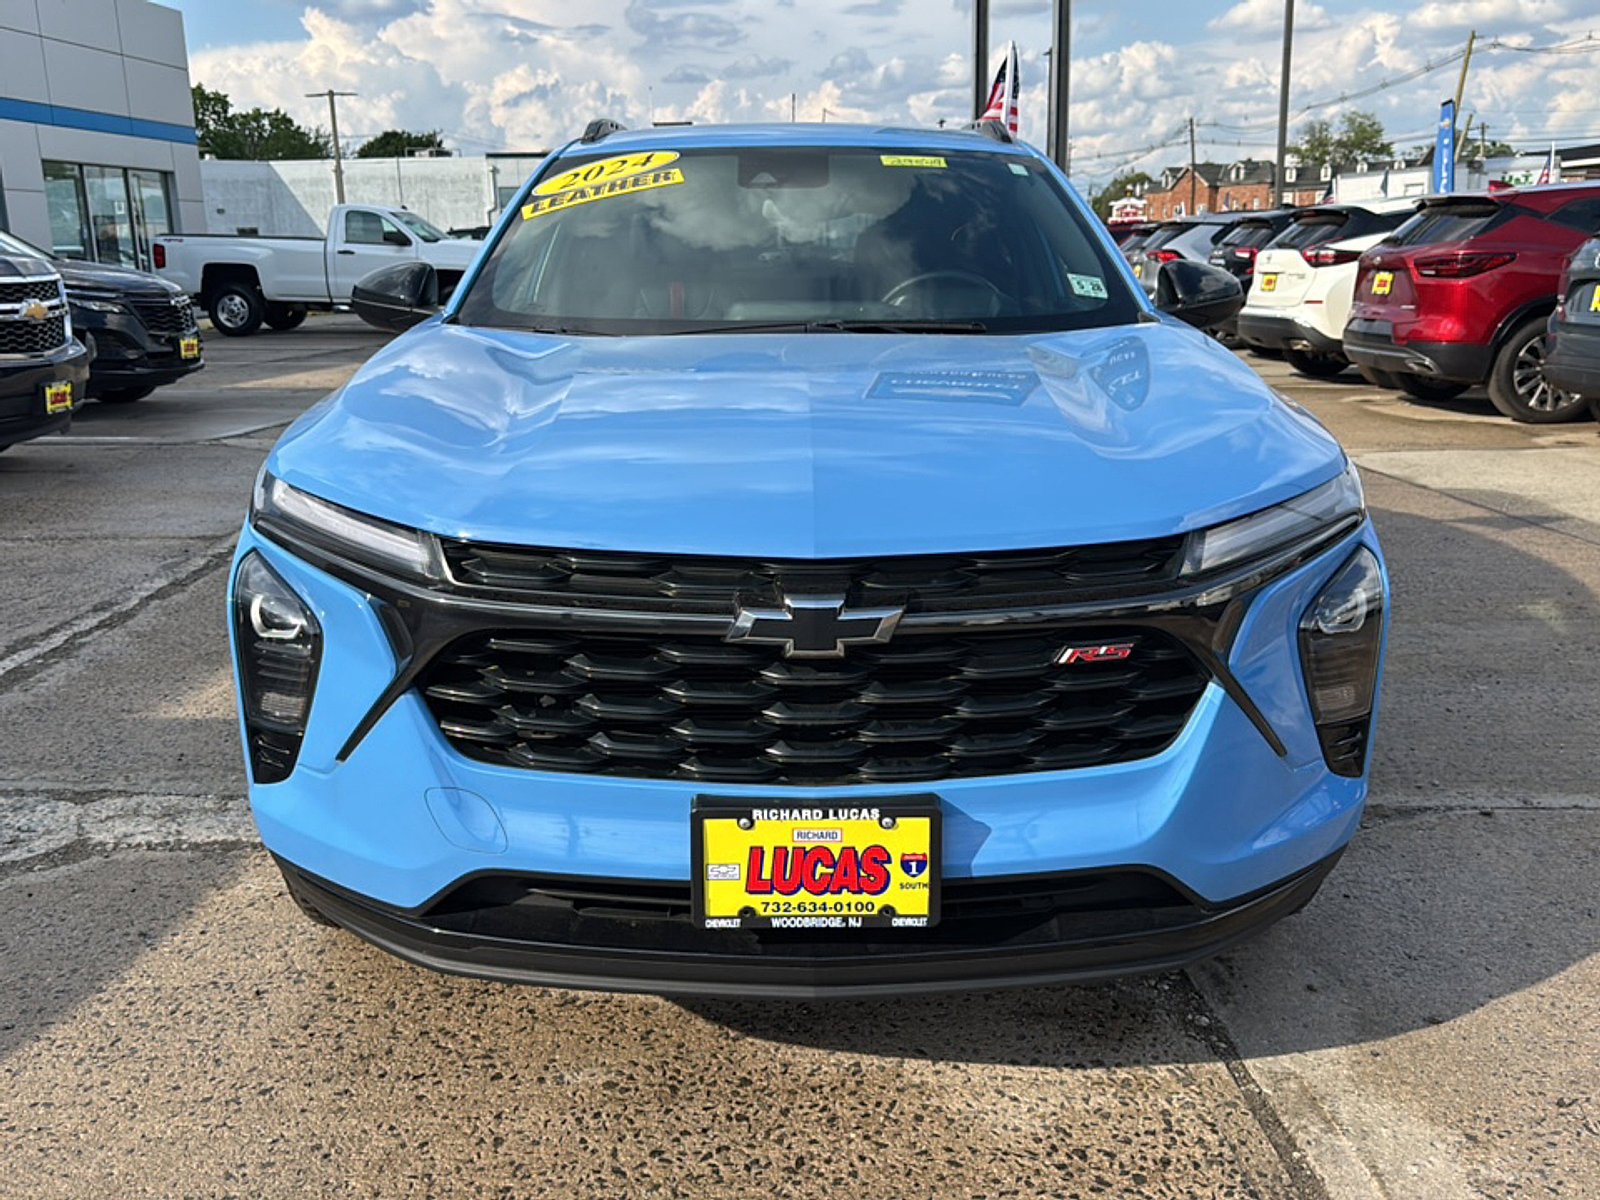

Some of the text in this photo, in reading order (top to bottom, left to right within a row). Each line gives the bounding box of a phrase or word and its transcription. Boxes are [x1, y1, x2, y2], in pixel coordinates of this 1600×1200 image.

[559, 153, 655, 190] 2024
[530, 171, 676, 213] LEATHER
[1057, 643, 1134, 664] RS
[752, 808, 880, 820] RICHARD LUCAS
[796, 831, 838, 840] RICHARD
[746, 845, 893, 896] LUCAS
[908, 861, 920, 875] 1
[900, 882, 929, 890] SOUTH
[761, 902, 875, 912] 732-634-0100
[848, 917, 863, 927] NJ
